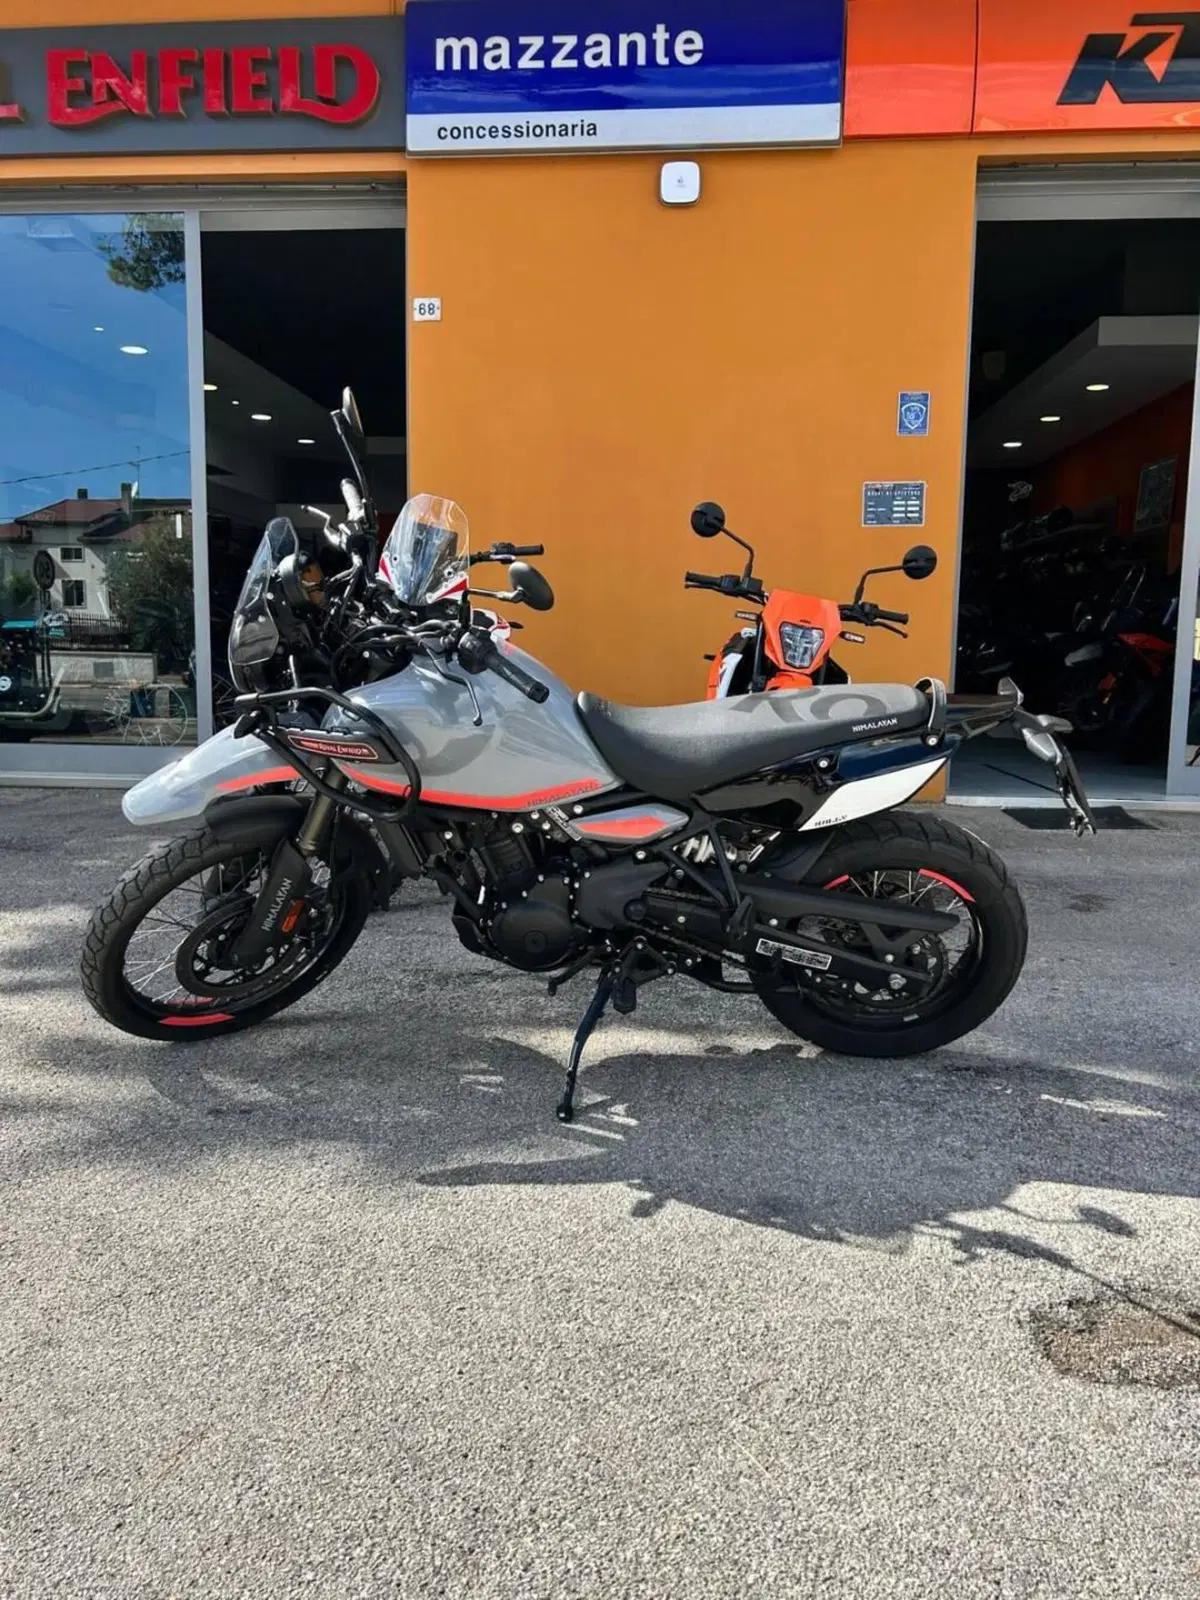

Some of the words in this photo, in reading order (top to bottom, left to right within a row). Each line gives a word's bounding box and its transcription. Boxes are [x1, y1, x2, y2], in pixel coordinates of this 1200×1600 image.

[435, 23, 704, 71] mazzante
[46, 43, 380, 126] ENFIELD
[437, 119, 598, 140] concessionaria
[418, 302, 436, 316] 68
[852, 717, 898, 733] HIMALAYAN
[261, 877, 292, 931] HIMALAYAN
